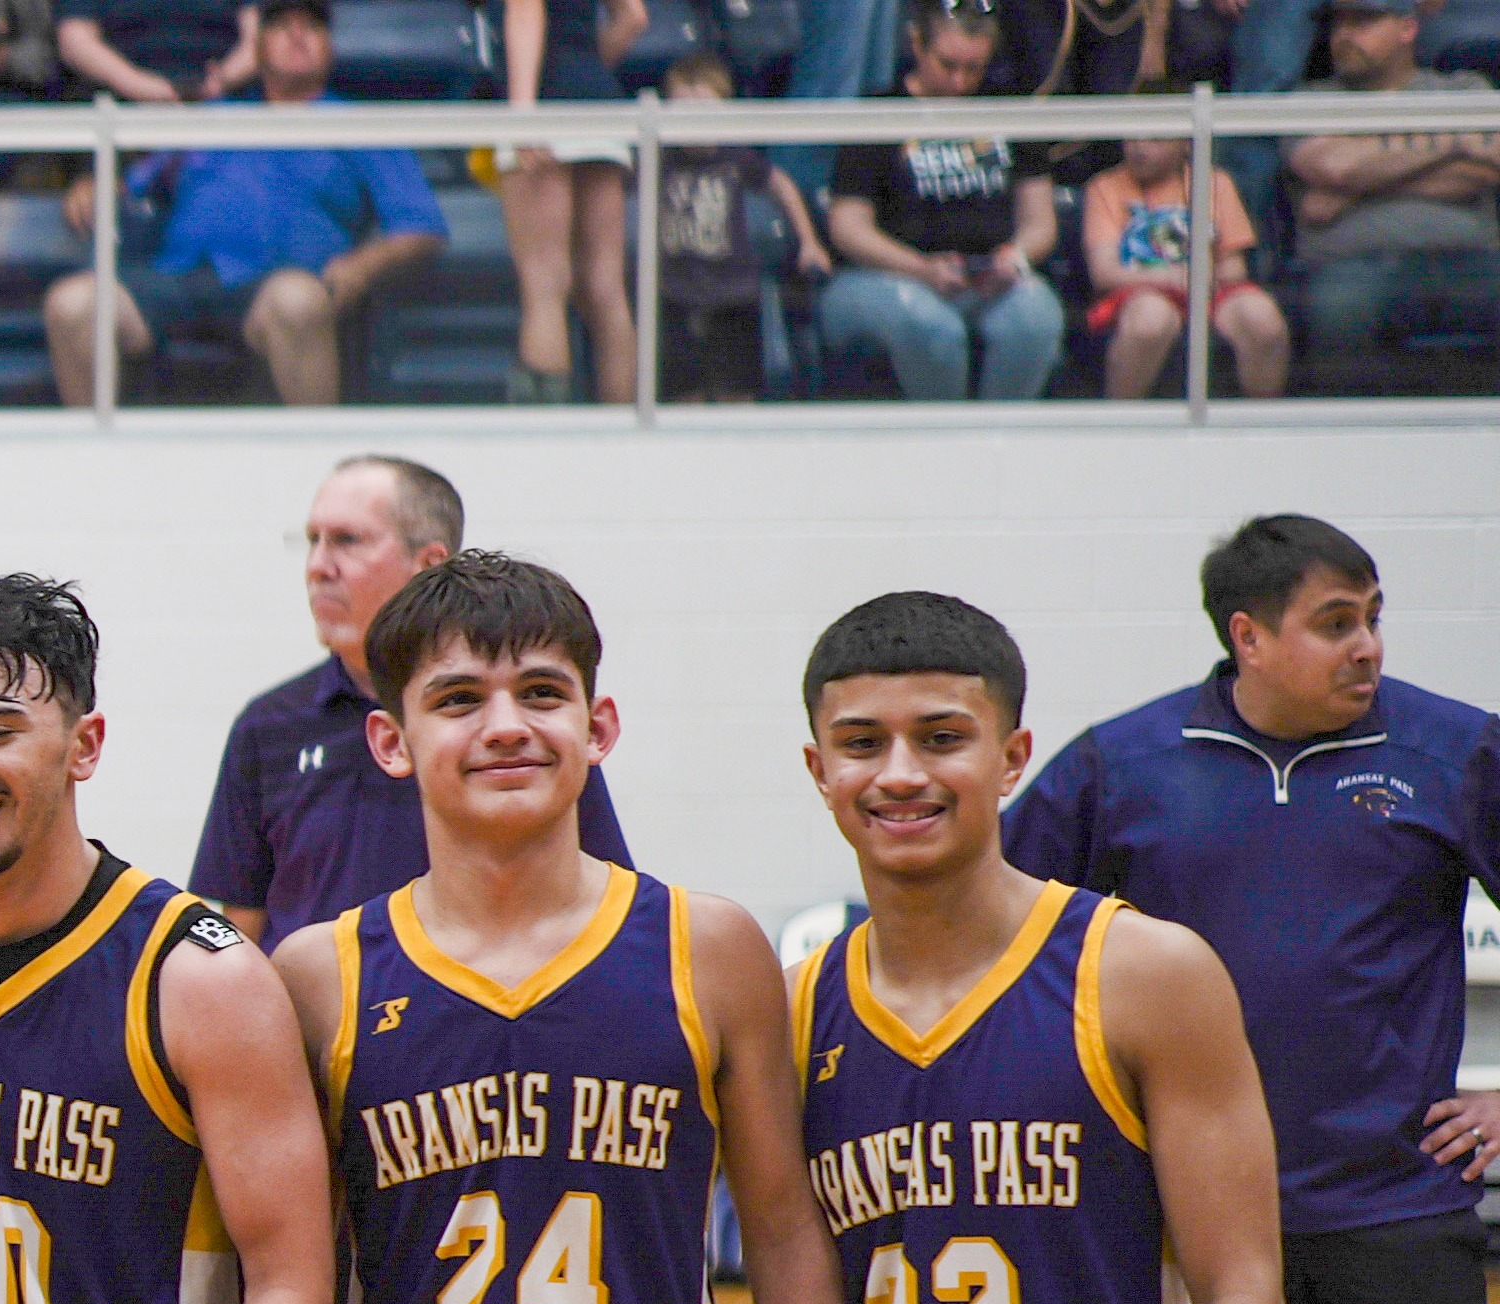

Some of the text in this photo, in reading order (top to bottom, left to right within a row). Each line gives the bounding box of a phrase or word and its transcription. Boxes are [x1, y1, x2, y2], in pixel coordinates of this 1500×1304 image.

[14, 1088, 121, 1186] PASS
[568, 1076, 681, 1170] PASS
[971, 1120, 1083, 1208] PASS
